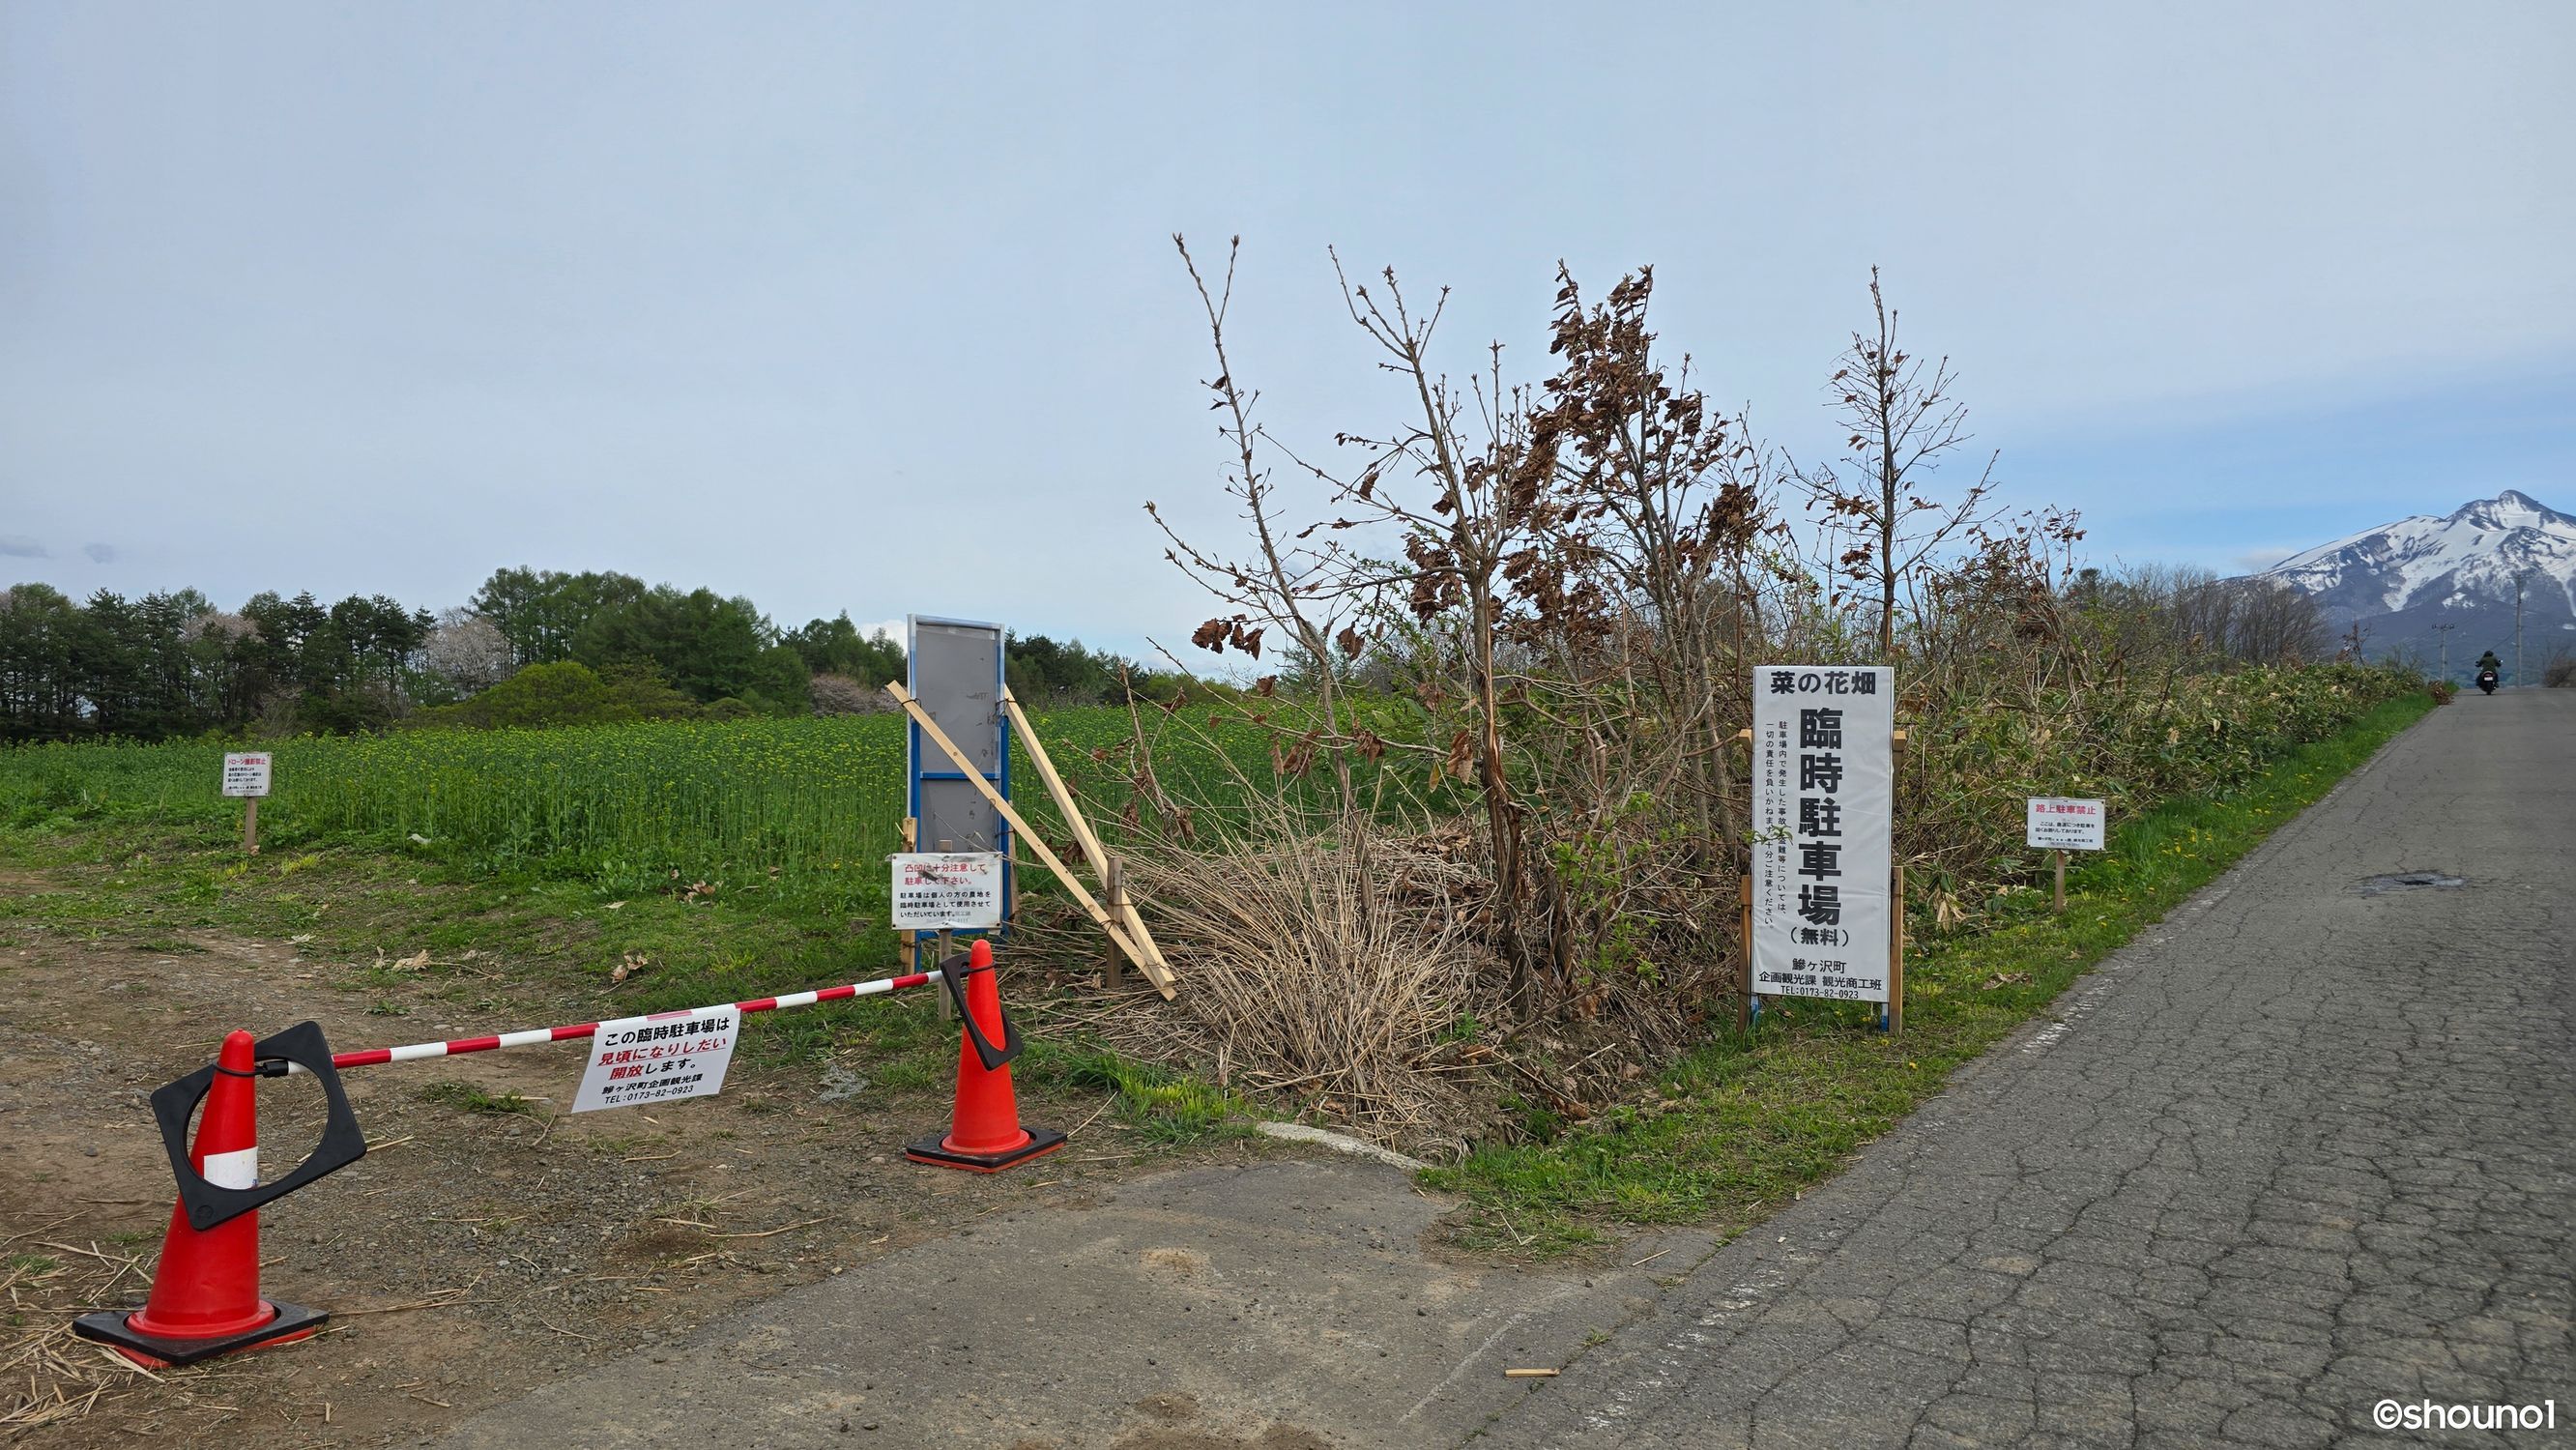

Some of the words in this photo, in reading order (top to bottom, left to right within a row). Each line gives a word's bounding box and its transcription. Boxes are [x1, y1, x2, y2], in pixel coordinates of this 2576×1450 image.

[1771, 671, 1876, 695] 菜の花畑
[1798, 708, 1842, 925] 臨時駐車場
[2036, 804, 2096, 814] 路上駐車禁止
[905, 863, 986, 873] 凸凹に十分注意して
[904, 876, 972, 885] 駐車して下さい。
[1758, 971, 1817, 985] 企画観光課
[1822, 975, 1882, 991] 観光商工班
[1780, 985, 1859, 1000] TEL:0173-82-0923
[605, 1017, 730, 1047] この臨時駐車場は
[599, 1037, 728, 1067] 見頃になりしだい
[611, 1058, 696, 1081] 開放します。
[604, 1085, 694, 1104] TEL:0173-82-0923
